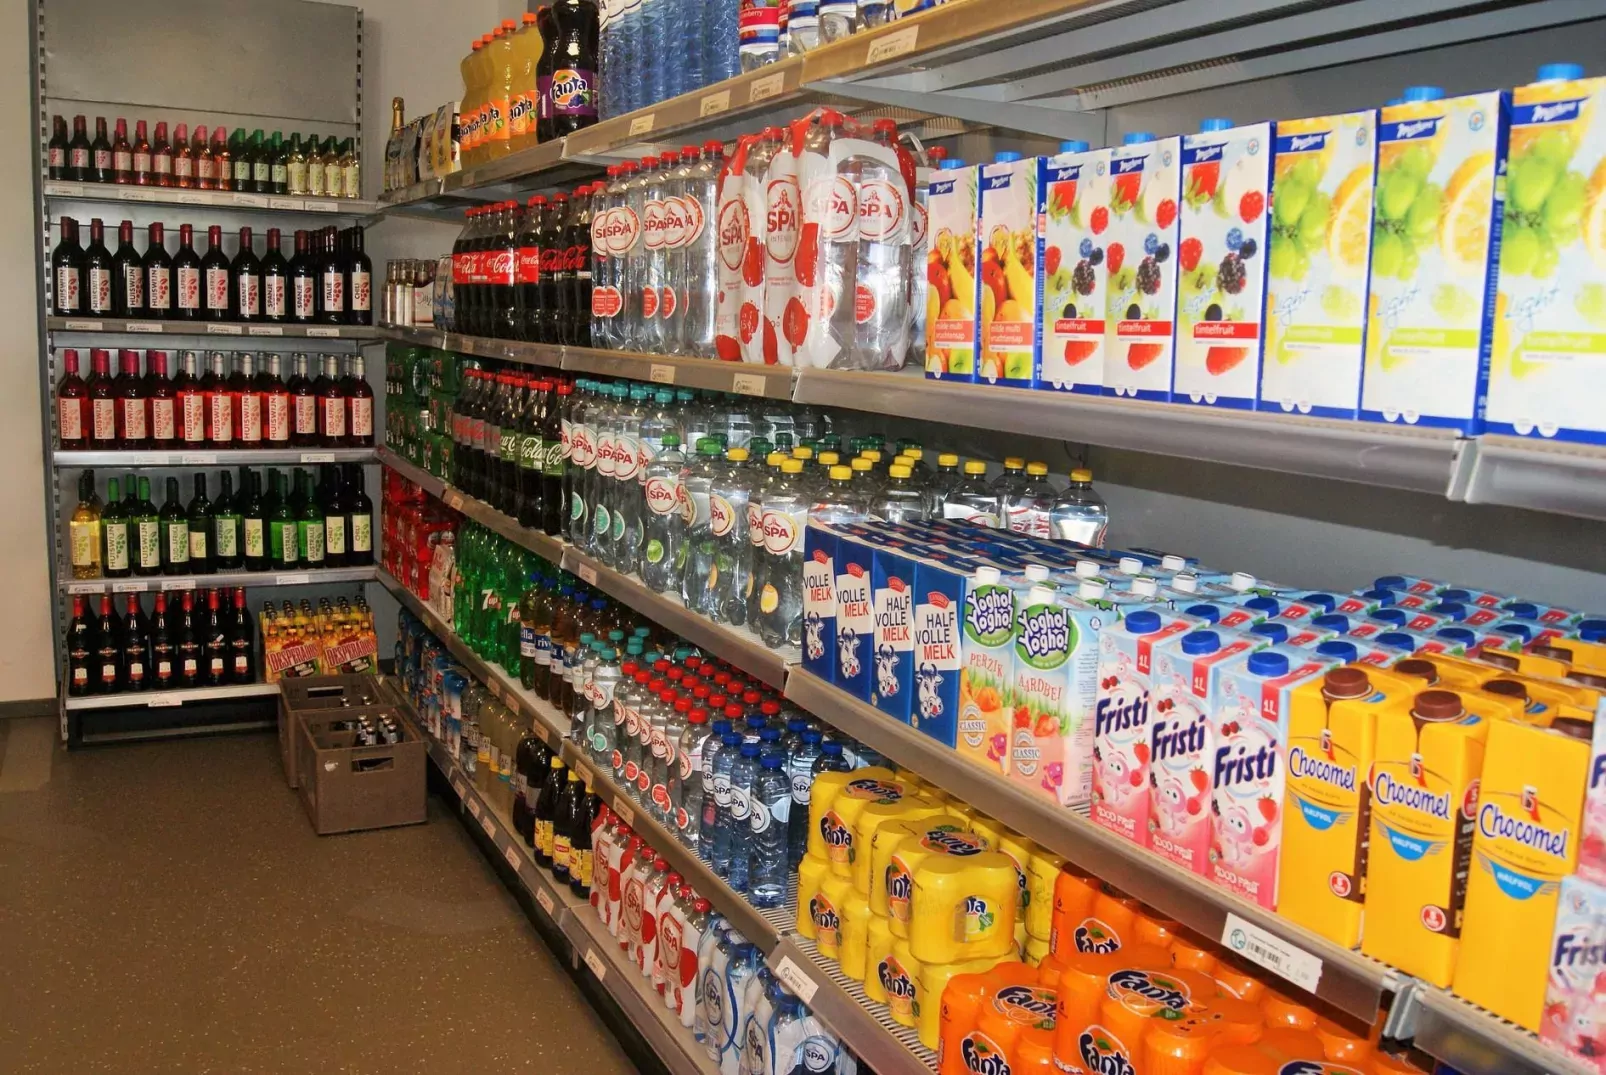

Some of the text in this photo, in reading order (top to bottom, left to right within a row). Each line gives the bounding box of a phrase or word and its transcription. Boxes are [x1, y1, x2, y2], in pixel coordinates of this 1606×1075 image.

[859, 202, 893, 218] SPA
[766, 209, 796, 233] SPA
[721, 224, 743, 246] SPA
[649, 490, 673, 501] SPA
[764, 528, 790, 539] SPA
[803, 573, 829, 589] VOLLE
[810, 587, 833, 602] MELK
[836, 588, 866, 604] VOLLE
[844, 602, 869, 618] MELK
[886, 595, 910, 612] HALF
[875, 611, 907, 628] VOLLE
[926, 611, 955, 628] HALF
[882, 627, 910, 642] MELK
[915, 628, 951, 645] VOLLE
[923, 644, 956, 660] MELK
[970, 652, 1004, 677] PERZIK
[1095, 691, 1149, 738] Fristi
[960, 721, 987, 731] CLASSIC
[1151, 714, 1206, 763] Fristi
[1012, 748, 1041, 759] CLASSIC
[1213, 739, 1278, 790] Fristi
[1289, 747, 1357, 792] Chocomel
[1375, 773, 1452, 820] Chocomel
[820, 815, 852, 846] Fanta
[1480, 803, 1567, 859] Chocomel
[809, 897, 840, 930] Fanta
[878, 961, 916, 999] Fanta
[1109, 969, 1190, 1011] Fanta
[805, 1049, 826, 1061] SPA
